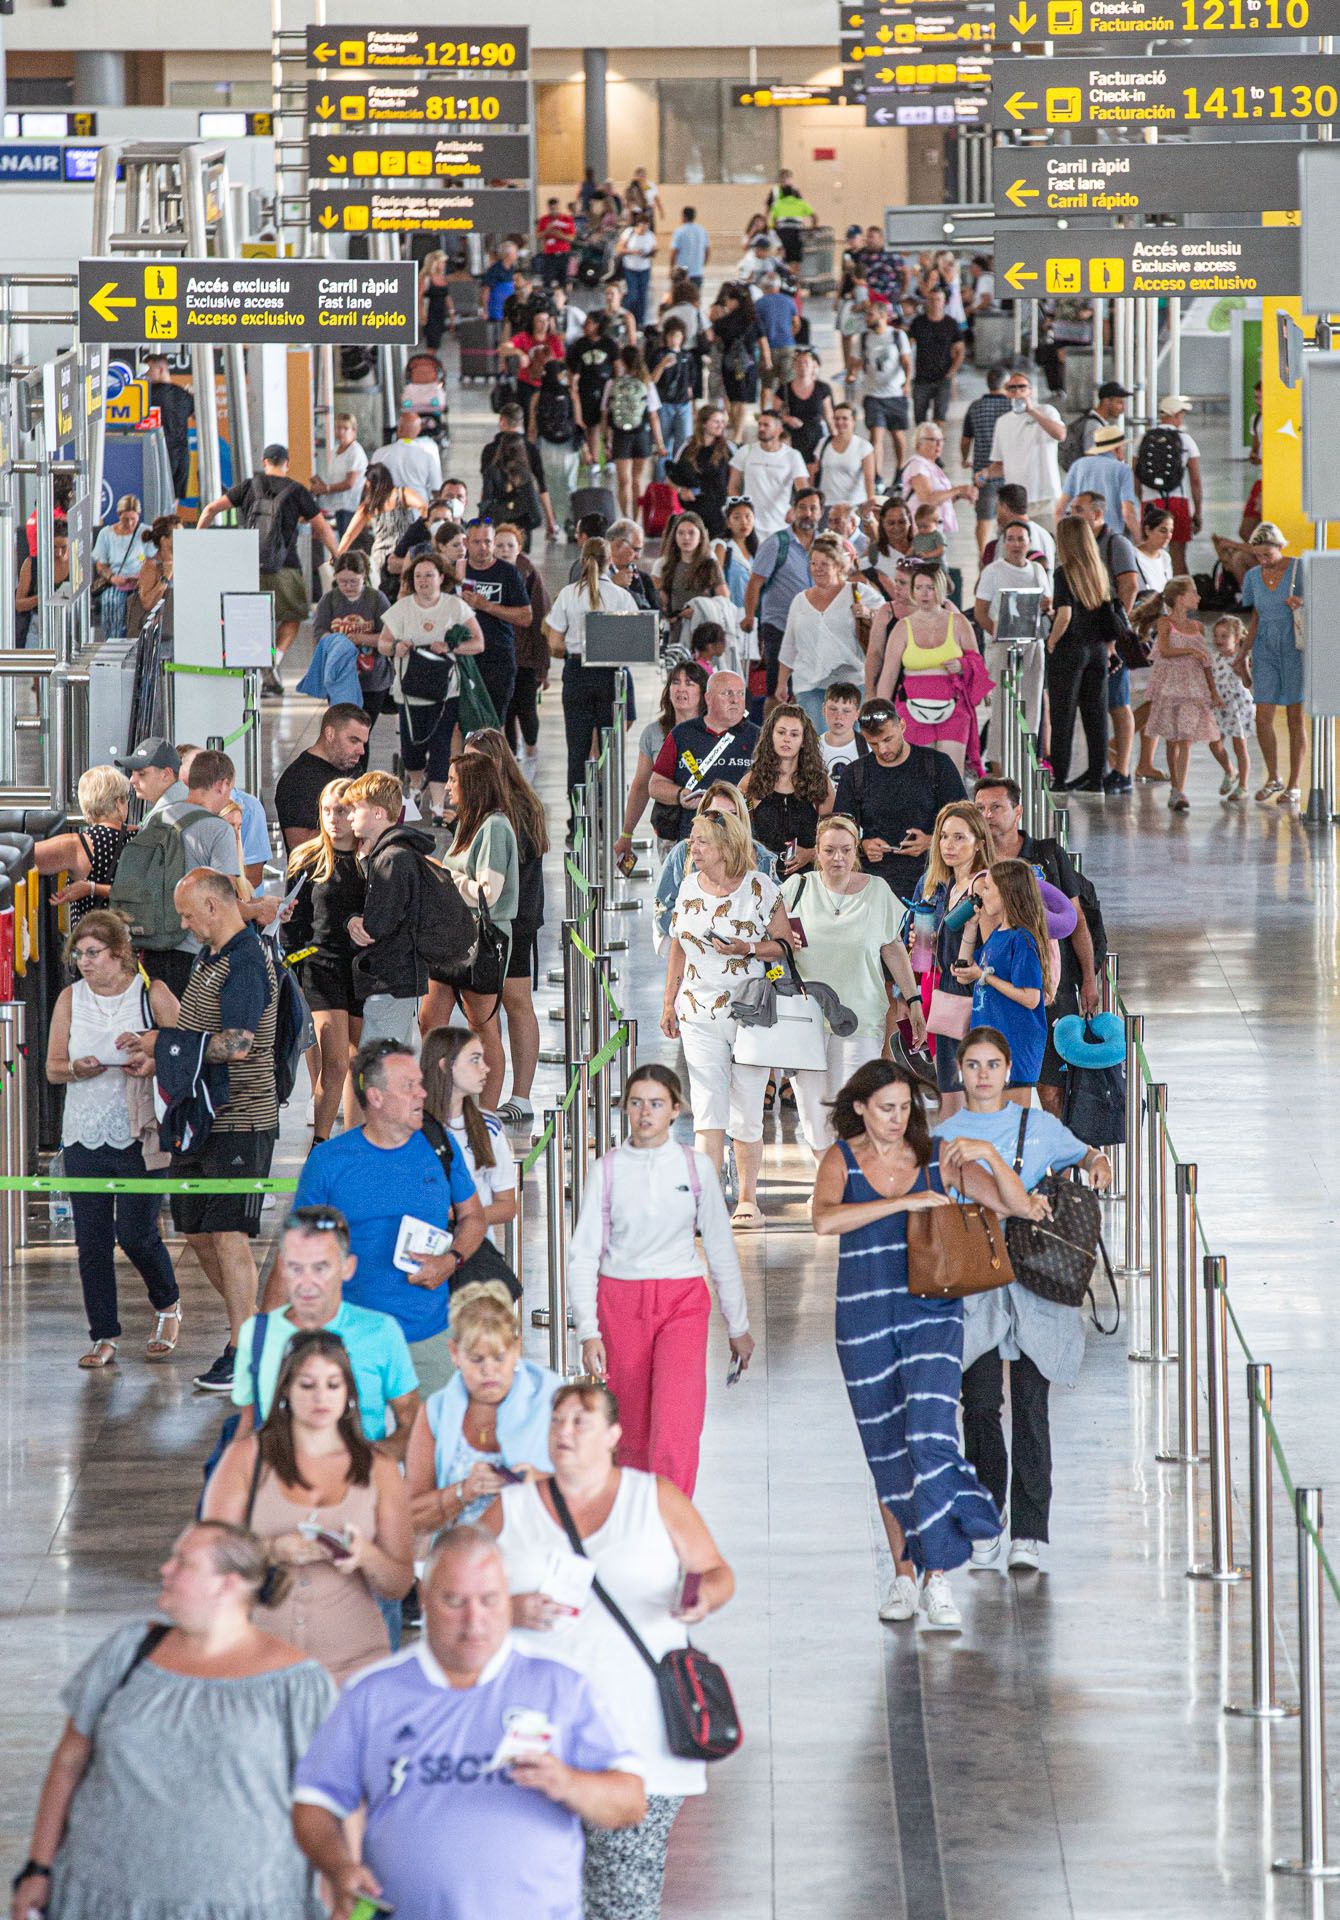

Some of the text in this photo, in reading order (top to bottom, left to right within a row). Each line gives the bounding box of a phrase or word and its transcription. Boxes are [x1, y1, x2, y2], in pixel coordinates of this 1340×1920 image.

[1090, 1, 1145, 15] Check-in
[1182, 0, 1309, 30] 121 to 10
[1089, 17, 1174, 32] Facturación
[1249, 18, 1259, 28] a
[425, 42, 470, 66] 121
[481, 43, 515, 66] 90
[1089, 70, 1168, 87] Facturació
[1089, 89, 1146, 104] Check-in
[1183, 85, 1338, 119] 141 to 130
[426, 96, 458, 120] 81
[467, 96, 499, 120] 10
[1088, 104, 1175, 120] Facturación
[1252, 106, 1262, 117] a
[1047, 158, 1130, 176] Carril ràpid
[1048, 177, 1106, 191] Fast lane
[1047, 192, 1139, 210] Carril rápido
[1132, 241, 1241, 256] Accés exclusiu
[1132, 259, 1237, 274] Exclusive access
[186, 277, 289, 293] Accés exclusiu
[319, 278, 398, 296] Carril ràpid
[1133, 275, 1257, 291] Acceso exclusivo
[186, 295, 284, 308] Exclusive access
[319, 296, 372, 309] Fast lane
[187, 311, 304, 325] Acceso exclusivo
[319, 311, 406, 328] Carril rápido
[728, 757, 754, 767] ASS
